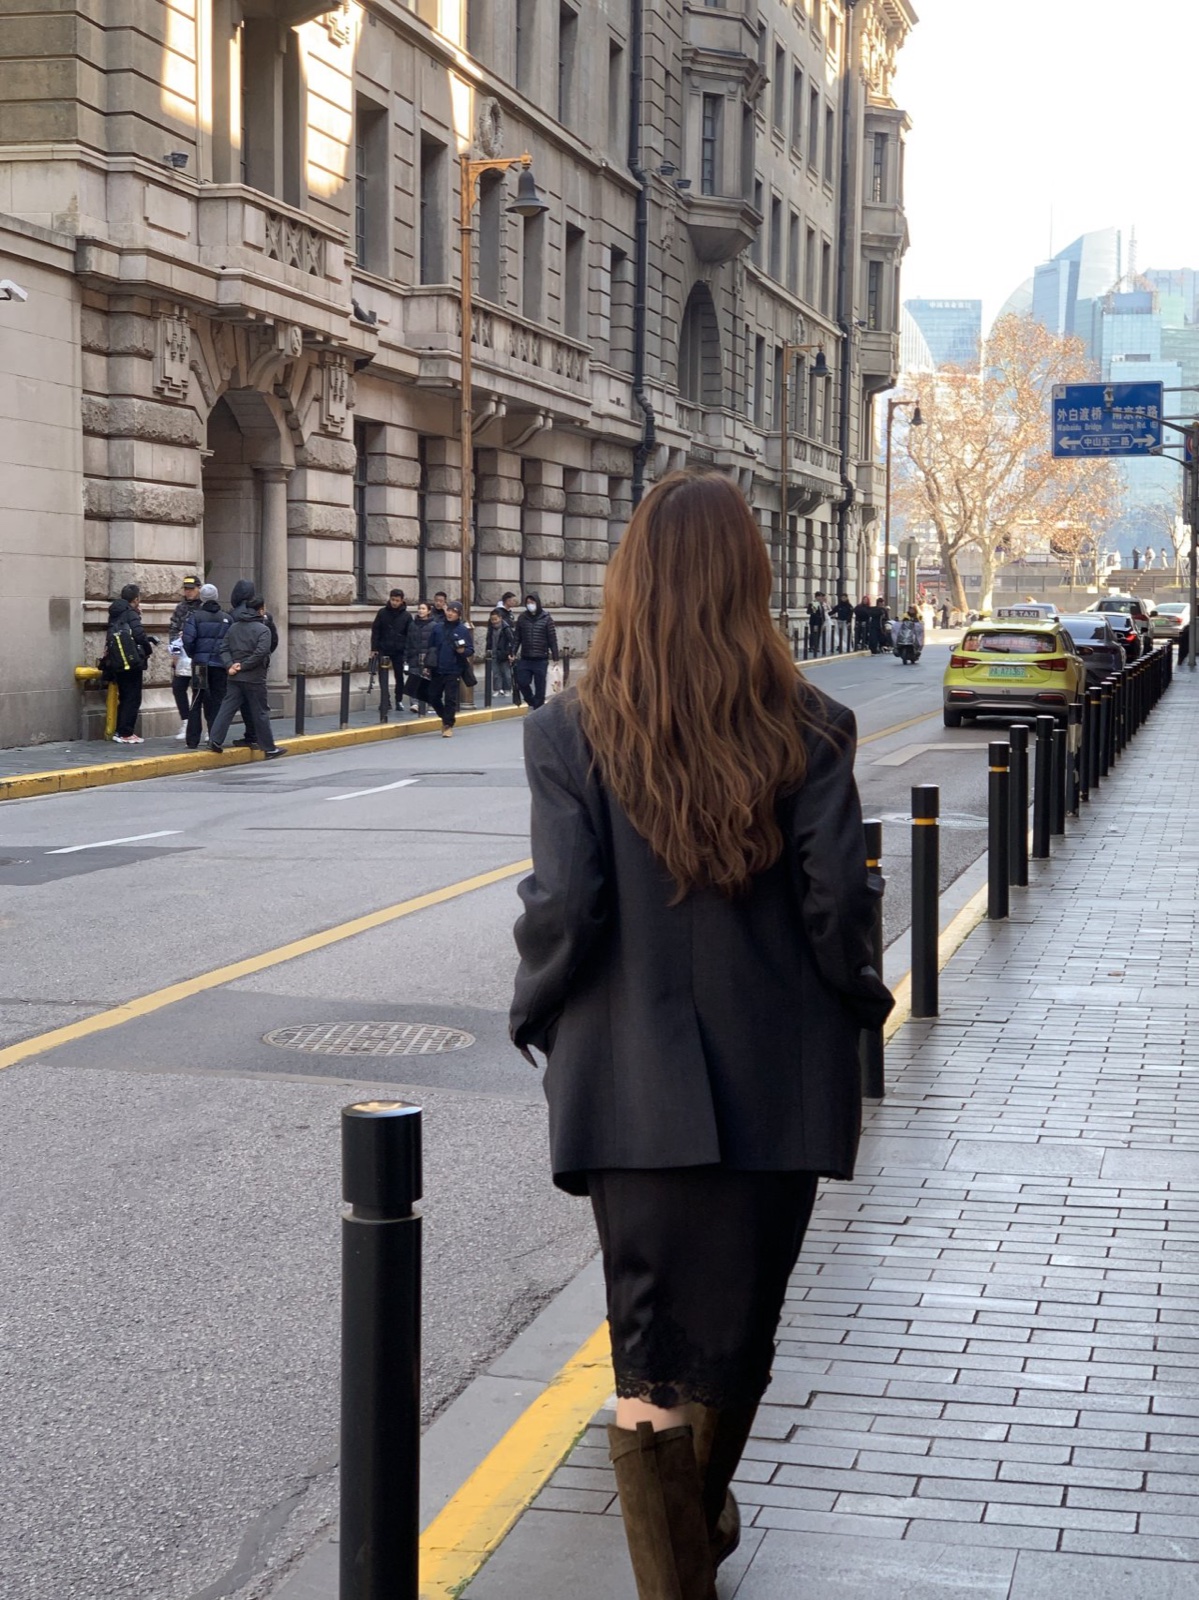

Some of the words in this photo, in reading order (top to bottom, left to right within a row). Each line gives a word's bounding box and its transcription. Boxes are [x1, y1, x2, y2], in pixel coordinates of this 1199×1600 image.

[1057, 407, 1102, 421] 外白渡桥
[1112, 405, 1158, 420] 南京东路
[1084, 436, 1130, 447] 中山东一路
